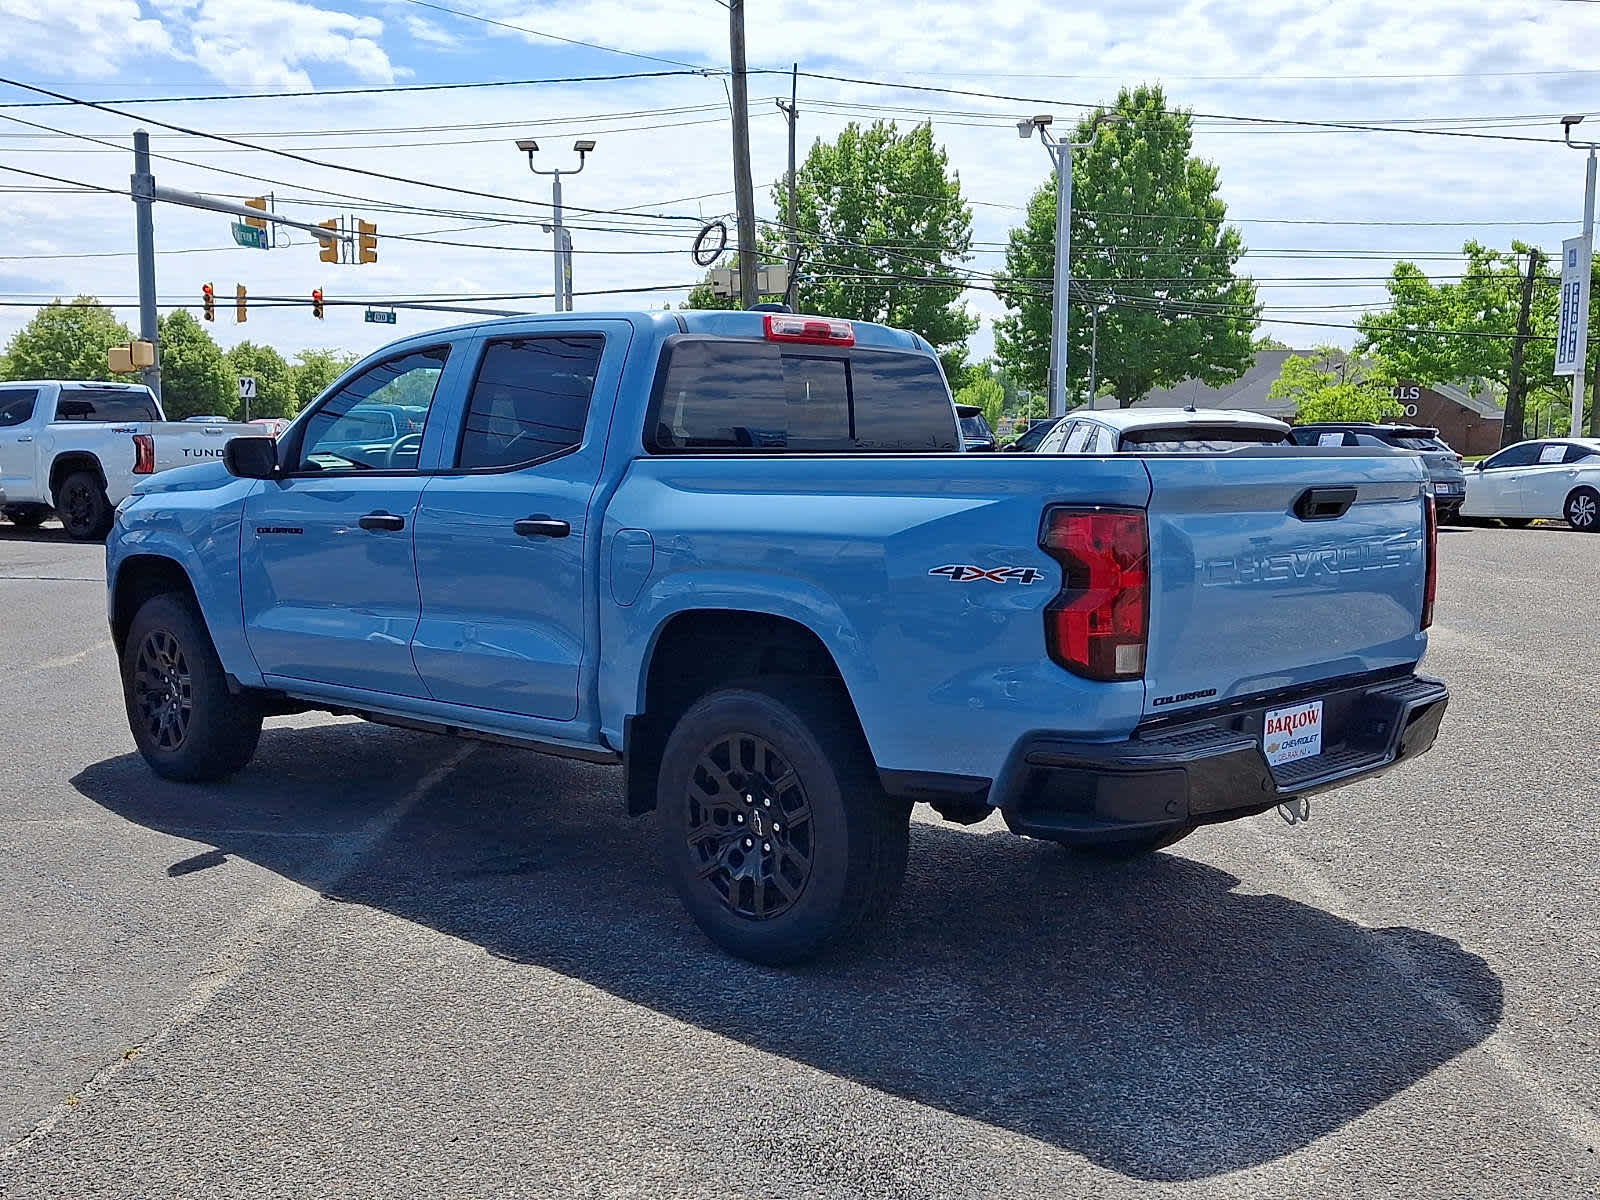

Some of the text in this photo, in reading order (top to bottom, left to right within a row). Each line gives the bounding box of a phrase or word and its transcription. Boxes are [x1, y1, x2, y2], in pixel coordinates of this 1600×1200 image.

[1203, 539, 1423, 587] CHEVROLET
[1152, 688, 1217, 706] COLORADO
[1266, 708, 1320, 736] BARLOW
[1282, 733, 1319, 750] CHEVROLET
